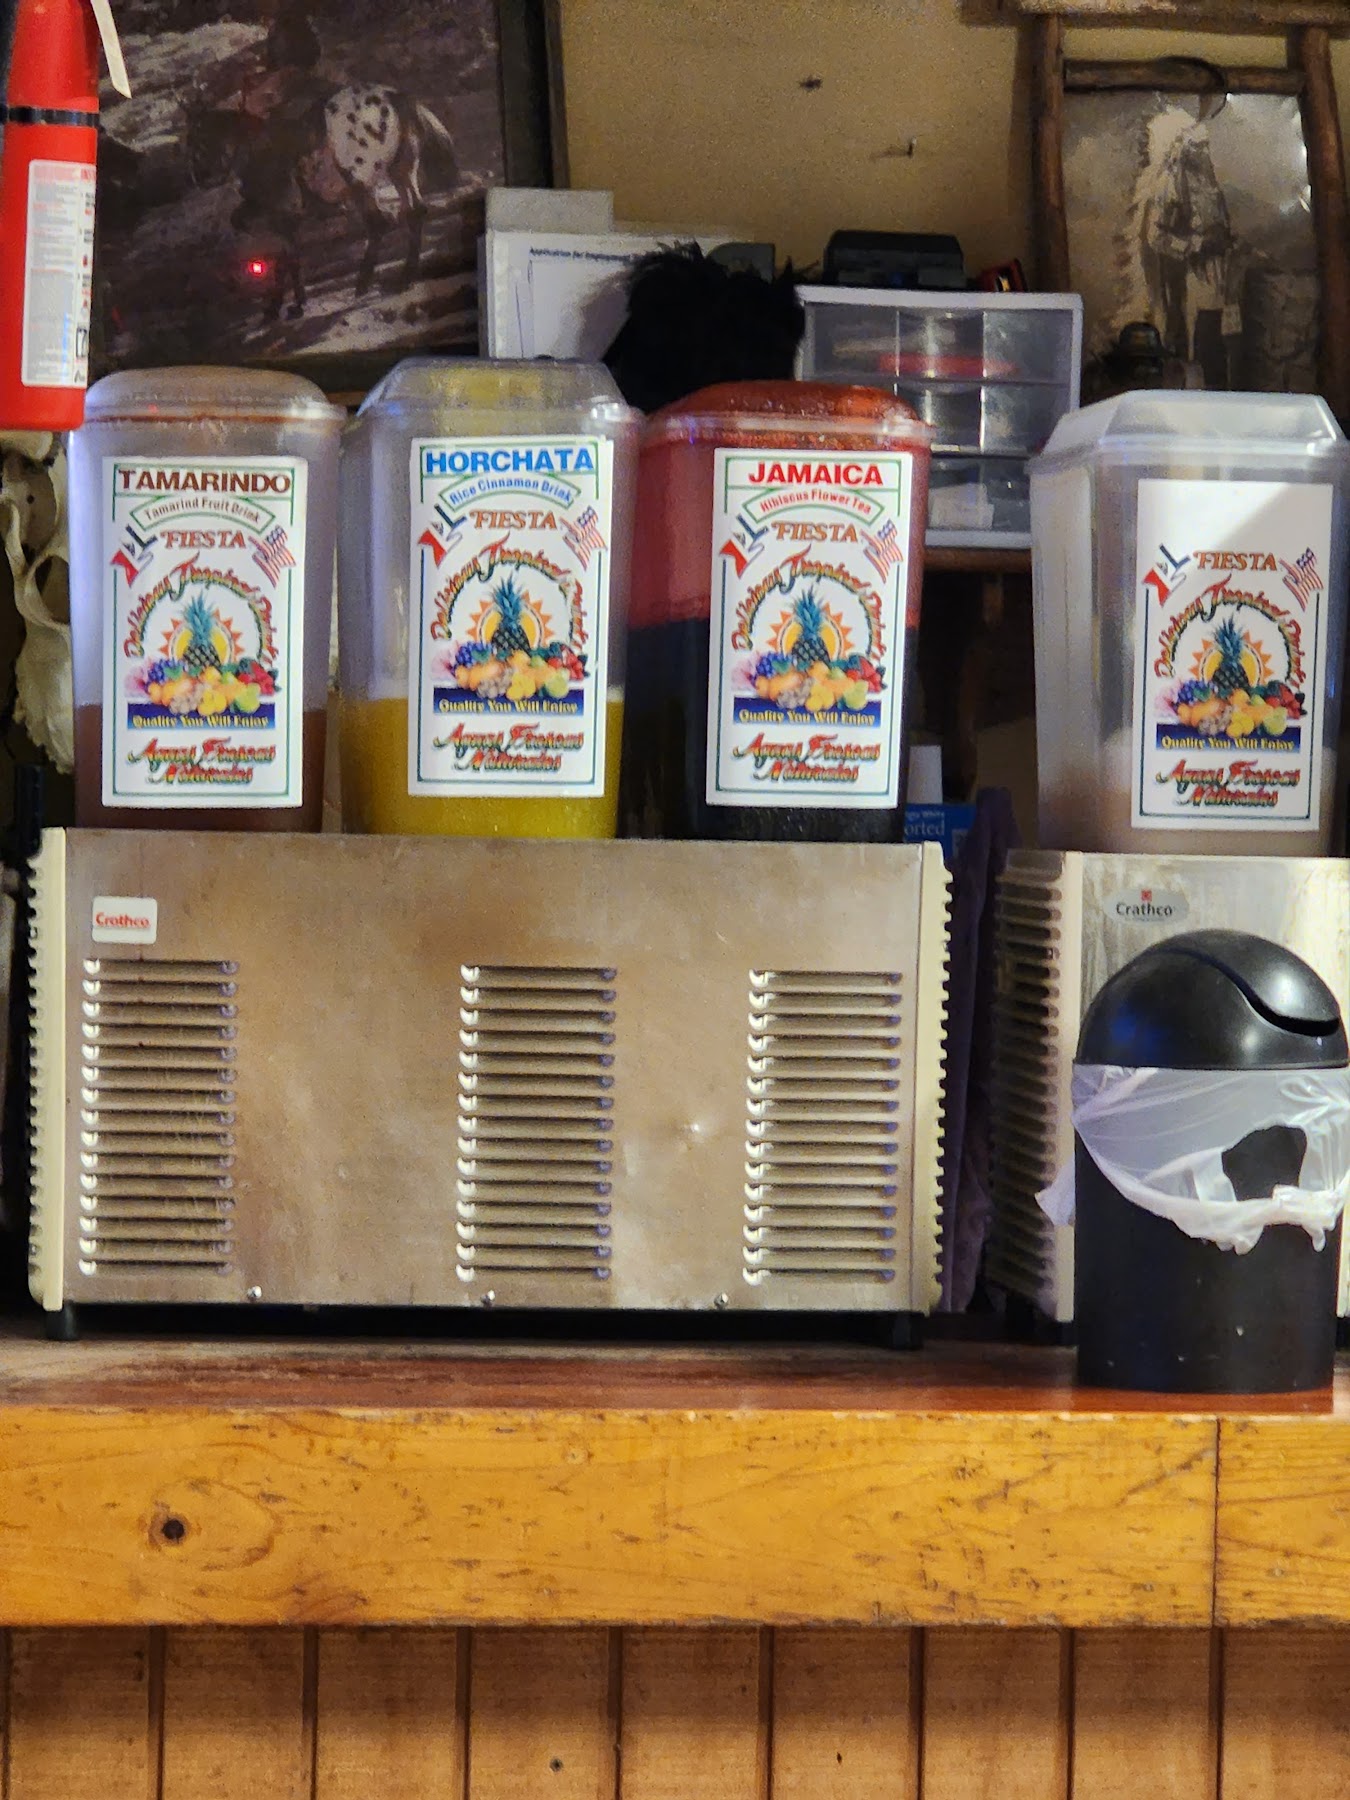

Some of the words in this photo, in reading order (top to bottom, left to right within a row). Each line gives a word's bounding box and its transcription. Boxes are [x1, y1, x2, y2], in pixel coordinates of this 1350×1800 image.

[426, 448, 594, 473] HORCHATA
[118, 469, 291, 493] TAMARINDO
[749, 462, 883, 485] JAMAICA
[450, 487, 477, 505] Rice
[478, 476, 539, 494] Cinnamon
[541, 481, 572, 502] Drink
[760, 492, 809, 512] Hibiscus
[811, 488, 849, 504] Flower
[853, 497, 871, 514] Tea
[144, 497, 199, 520] Tamarind
[201, 498, 229, 513] Fruit
[231, 502, 260, 523] Drink
[469, 509, 558, 530] FIESTA
[160, 529, 246, 549] FIESTA
[772, 520, 858, 542] FIESTA
[1193, 550, 1277, 571] FIESTA
[439, 699, 485, 713] Quality
[487, 699, 511, 713] You
[515, 699, 540, 713] Will
[543, 699, 577, 714] Enjoy
[132, 715, 177, 729] Quality
[180, 715, 203, 728] You
[207, 715, 231, 728] Will
[234, 715, 269, 729] Enjoy
[739, 709, 784, 724] Quality
[787, 709, 811, 724] You
[814, 710, 838, 725] Will
[841, 711, 875, 726] Enjoy
[1161, 735, 1204, 750] Quality
[1208, 736, 1231, 750] You
[1234, 736, 1258, 750] Will
[1261, 736, 1295, 750] Enjoy
[1116, 901, 1173, 916] Crathco
[95, 911, 151, 928] Crathco
